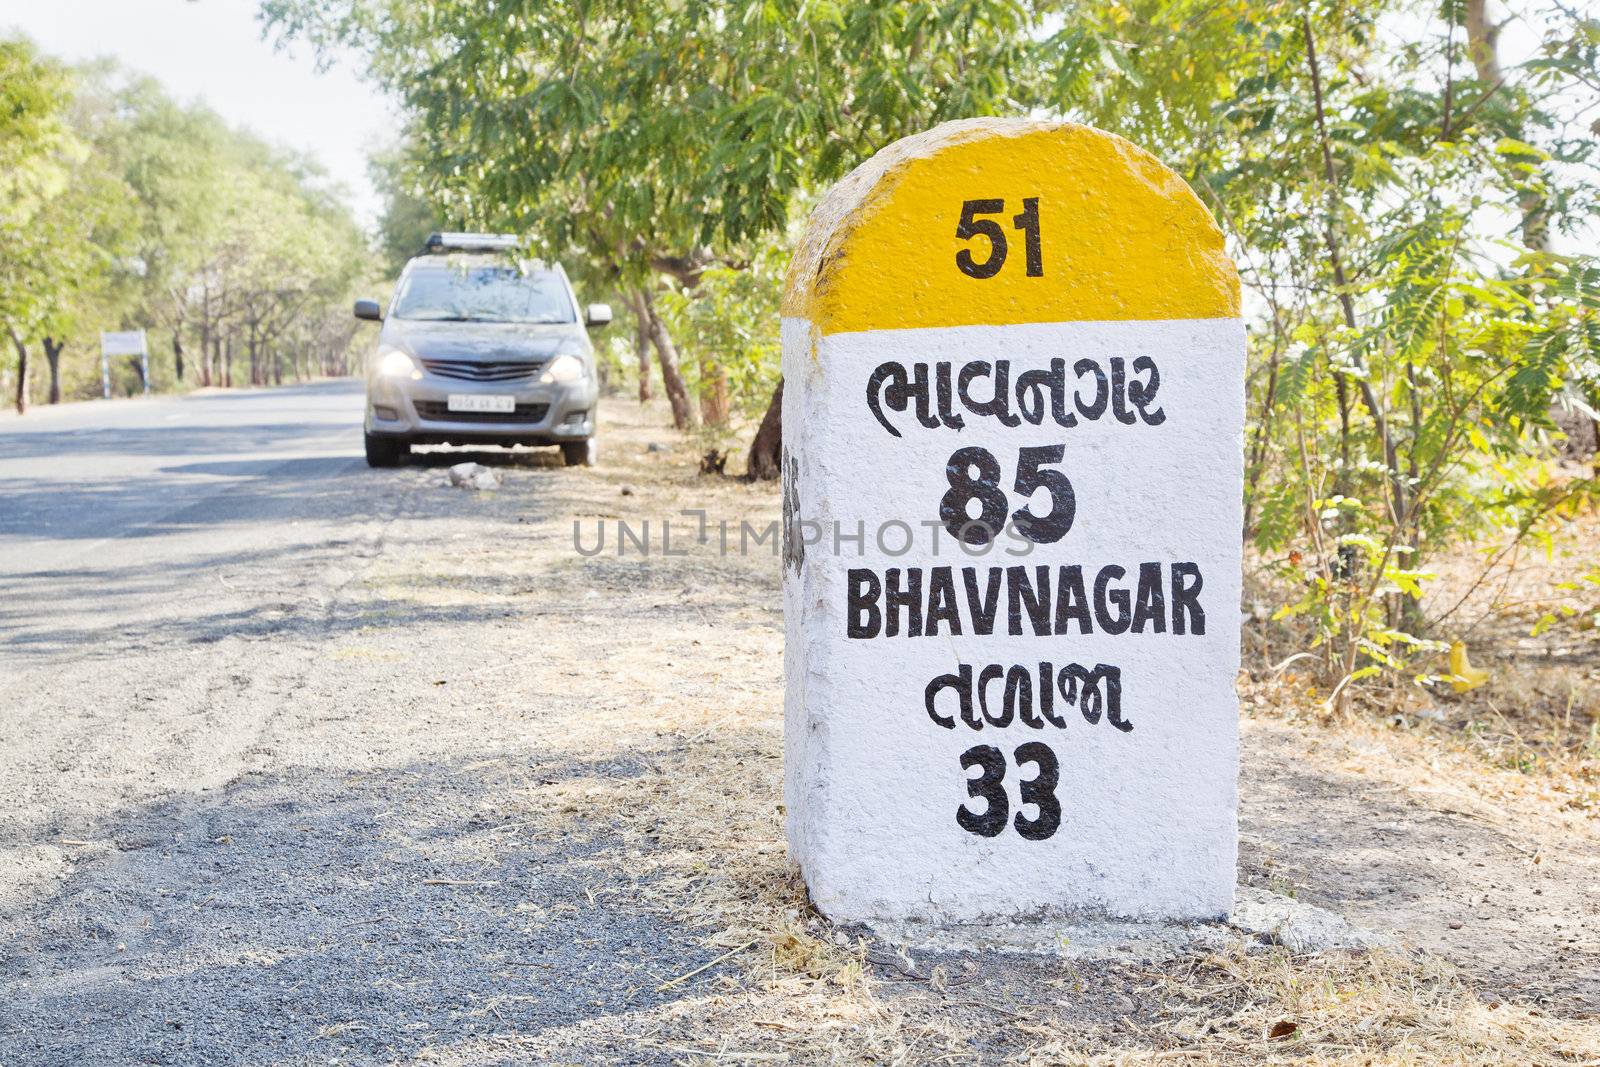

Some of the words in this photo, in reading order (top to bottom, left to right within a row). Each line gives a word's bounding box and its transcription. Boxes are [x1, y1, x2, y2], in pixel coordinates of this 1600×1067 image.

[956, 197, 1043, 278] 51
[866, 356, 1165, 437] ભાવનગર
[940, 445, 1075, 543] 85
[847, 562, 1205, 639] BHAVNAGAR
[957, 742, 1061, 840] 33
